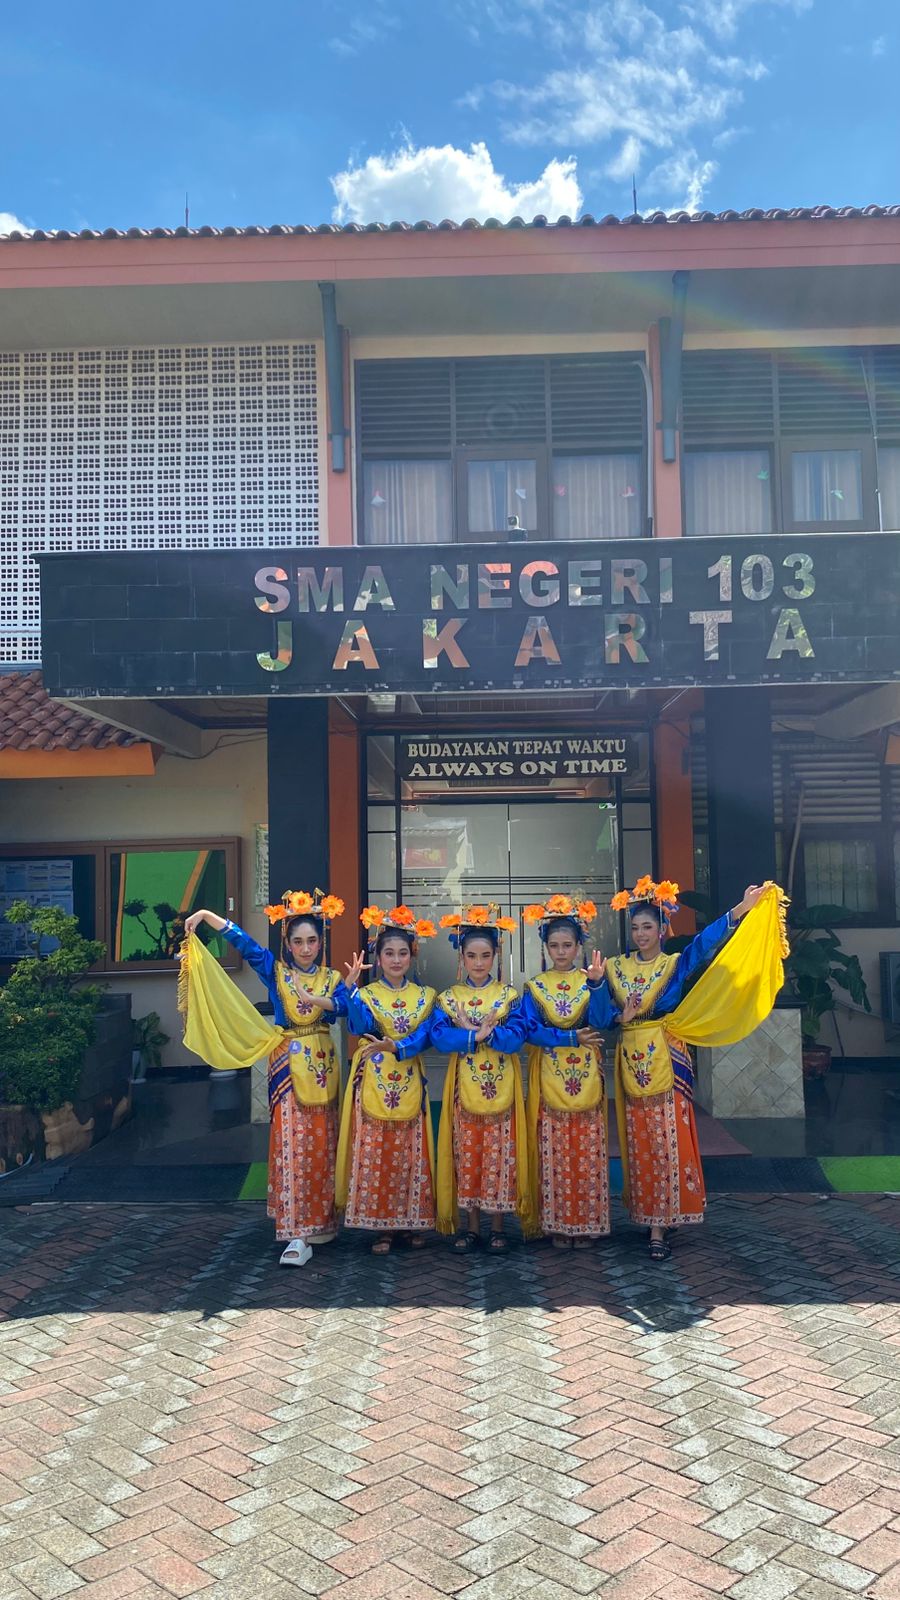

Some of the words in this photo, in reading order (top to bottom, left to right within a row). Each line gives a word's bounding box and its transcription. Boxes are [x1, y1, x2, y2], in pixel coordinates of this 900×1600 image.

[254, 565, 395, 614] SMA
[430, 557, 673, 610] NEGERI
[707, 552, 817, 602] 103
[256, 608, 816, 672] JAKARTA
[407, 741, 509, 758] BUDAYAKAN
[512, 739, 564, 755] TEPAT
[567, 739, 627, 754] WAKTU
[408, 760, 515, 777] ALWAYS
[520, 760, 558, 776] ON
[563, 758, 628, 775] TIME
